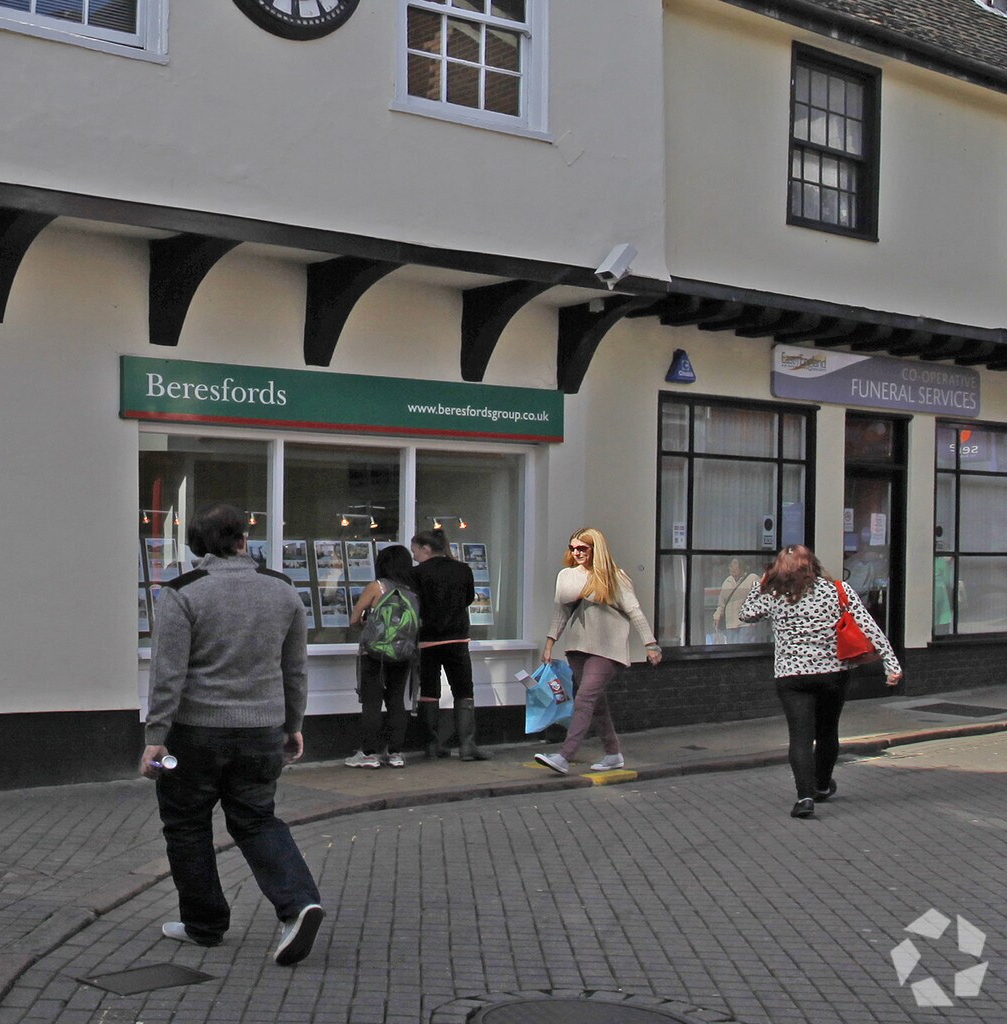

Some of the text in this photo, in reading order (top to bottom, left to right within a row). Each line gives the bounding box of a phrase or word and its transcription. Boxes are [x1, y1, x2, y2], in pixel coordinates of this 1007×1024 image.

[851, 378, 977, 410] FUNERAL SERVICES
[902, 367, 978, 389] CO-OPERATIVE
[146, 372, 549, 422] Beresfords www.beresfordsgroup.co.uk
